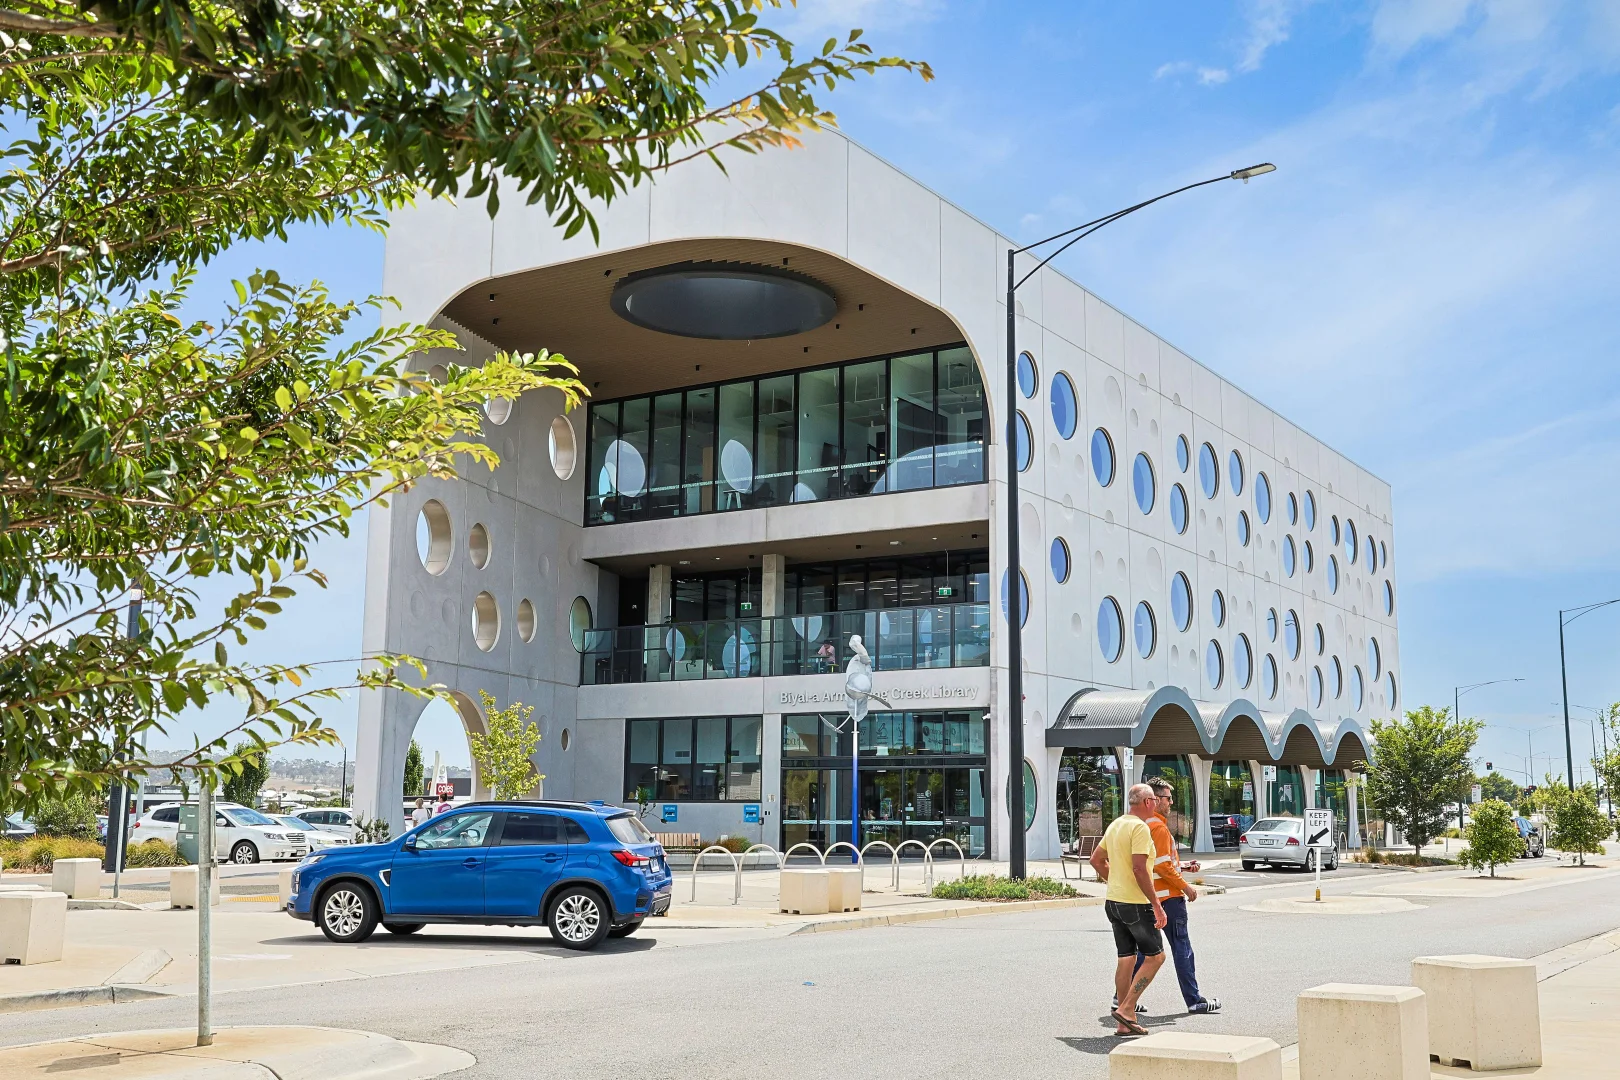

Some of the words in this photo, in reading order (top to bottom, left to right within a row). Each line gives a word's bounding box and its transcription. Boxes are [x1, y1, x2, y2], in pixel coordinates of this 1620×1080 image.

[780, 690, 820, 707] Biyal-a
[891, 685, 929, 699] Creek
[931, 685, 979, 700] Library
